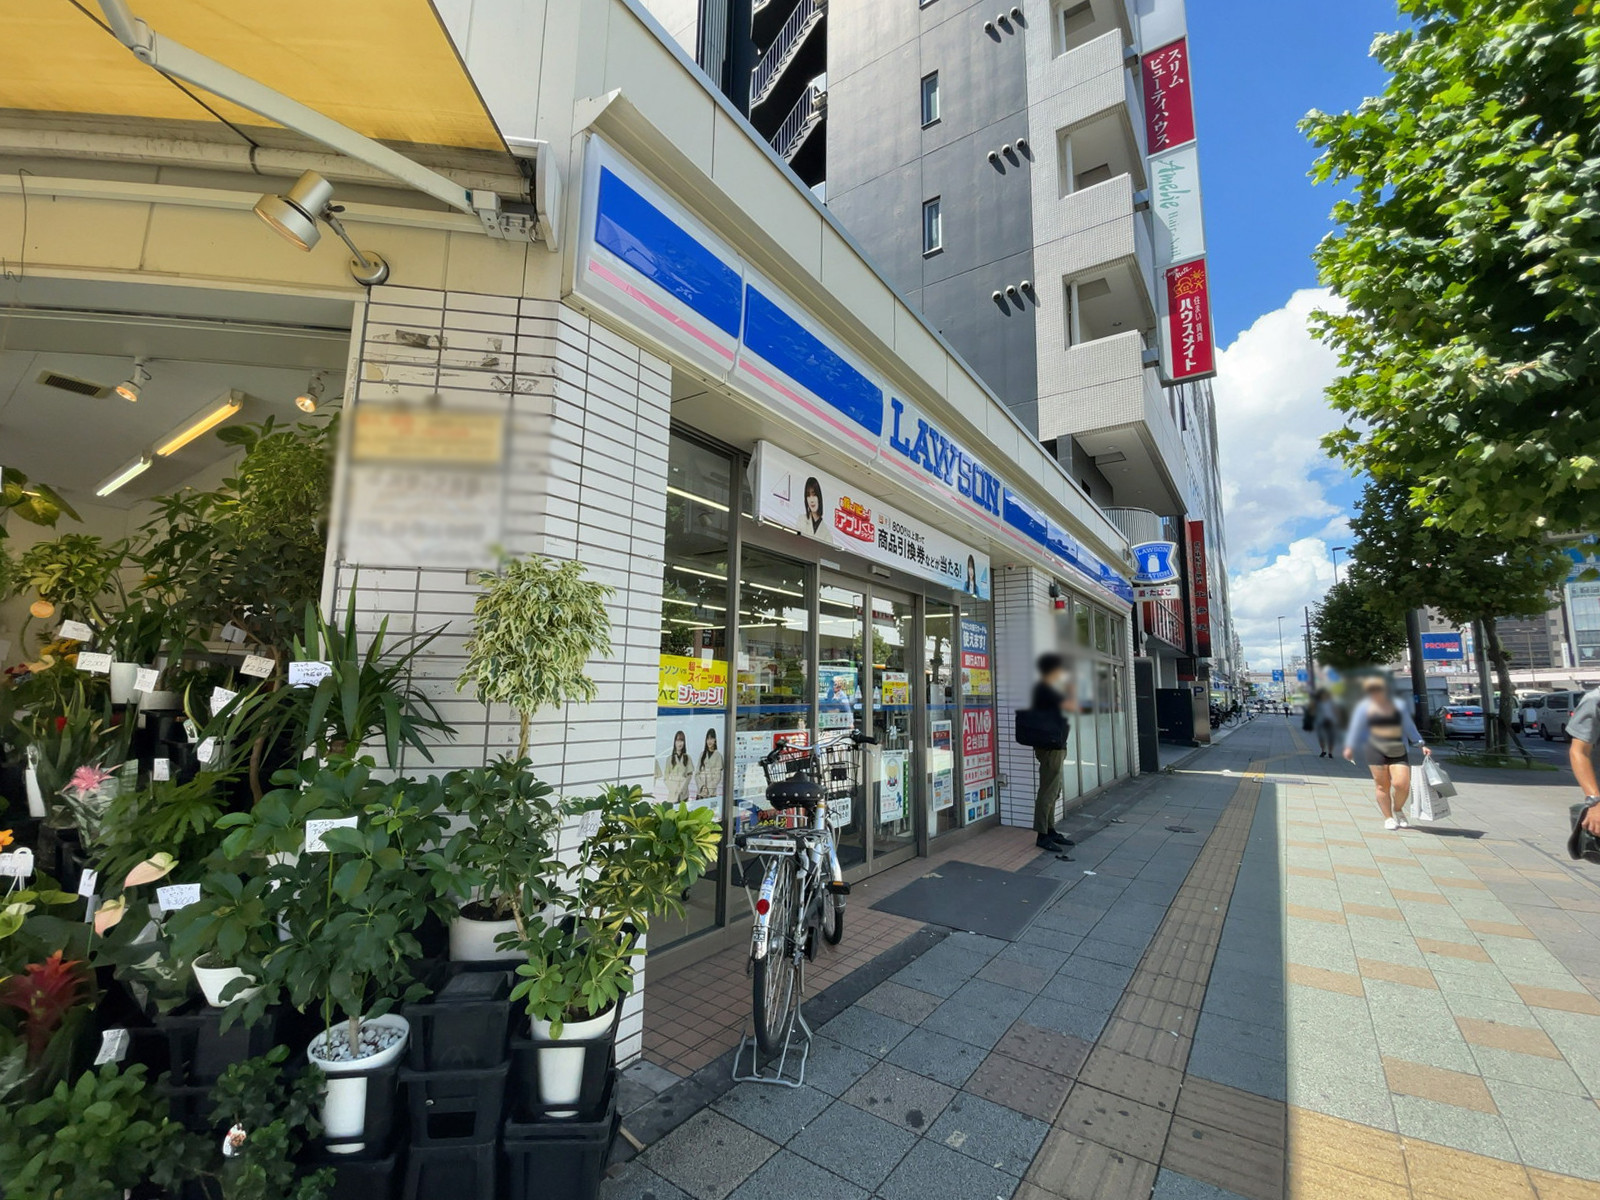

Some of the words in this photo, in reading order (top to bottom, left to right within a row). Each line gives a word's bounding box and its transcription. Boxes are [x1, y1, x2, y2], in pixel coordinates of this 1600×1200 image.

[1167, 48, 1184, 88] スリム
[1150, 53, 1170, 148] ビューティハウス
[1180, 298, 1197, 371] ハウスメイト
[890, 397, 1000, 517] LAWSON
[1137, 547, 1169, 555] LAWSON
[679, 686, 724, 705] ジャッジ!
[1194, 686, 1204, 697] P
[963, 711, 983, 735] ATM
